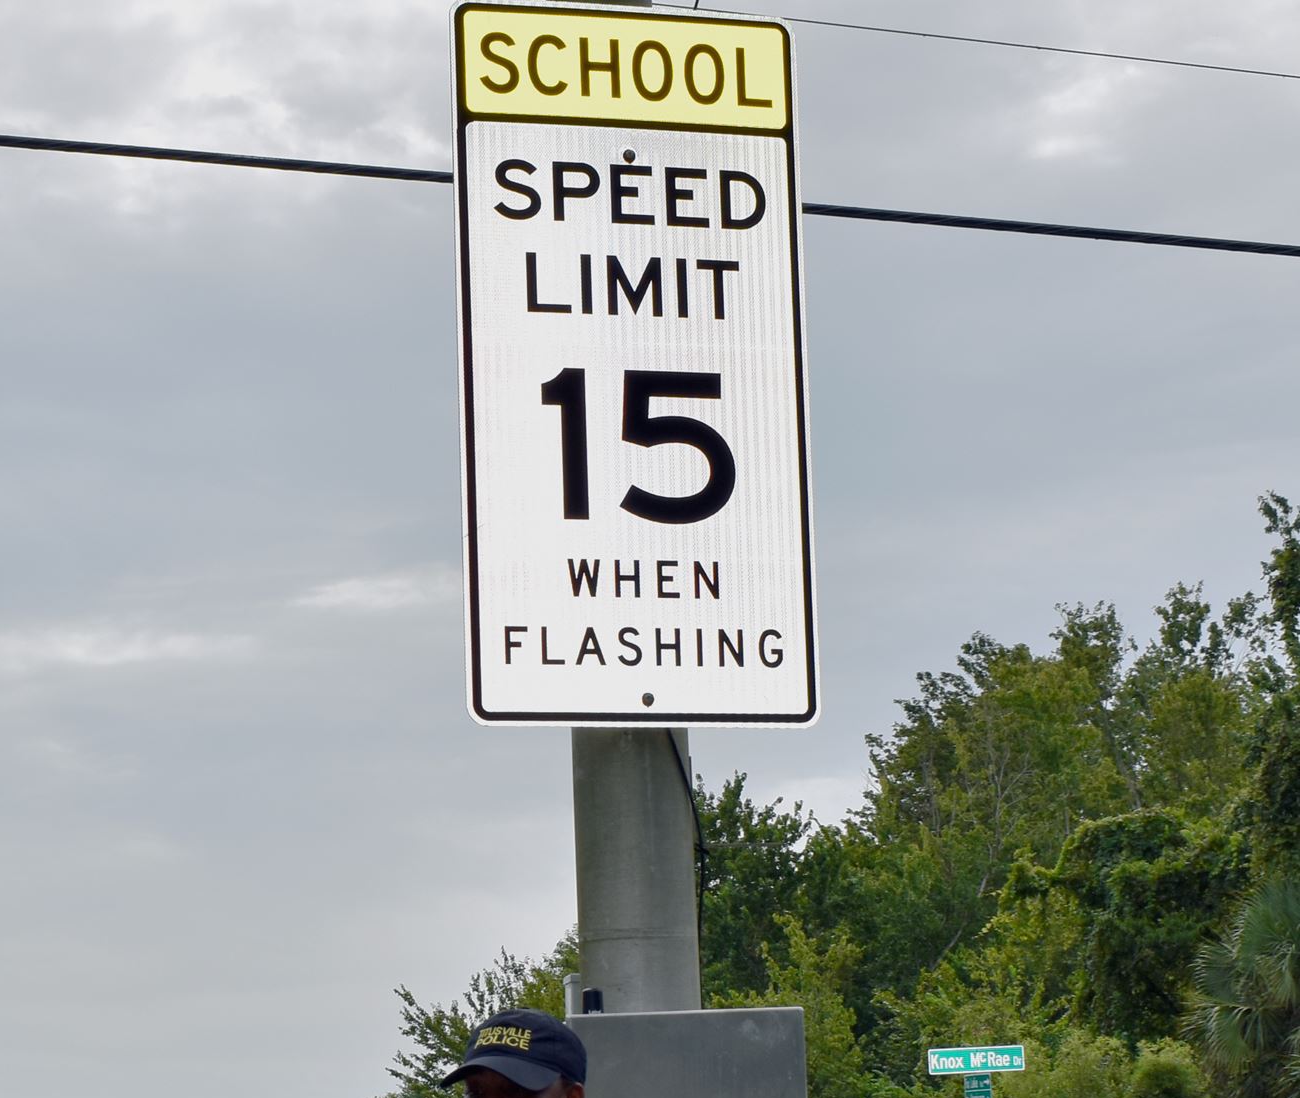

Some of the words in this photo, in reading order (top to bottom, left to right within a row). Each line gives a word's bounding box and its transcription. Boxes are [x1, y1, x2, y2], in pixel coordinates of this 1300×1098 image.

[479, 32, 773, 109] SCHOOL
[493, 158, 766, 230] SPEED
[525, 251, 740, 320] LIMIT
[541, 367, 736, 524] 15
[567, 558, 721, 600] WHEN
[504, 626, 785, 668] FLASHING
[474, 1034, 530, 1050] POLICE
[931, 1054, 964, 1070] Knox
[970, 1052, 1010, 1067] McRae
[1013, 1055, 1021, 1066] Dr
